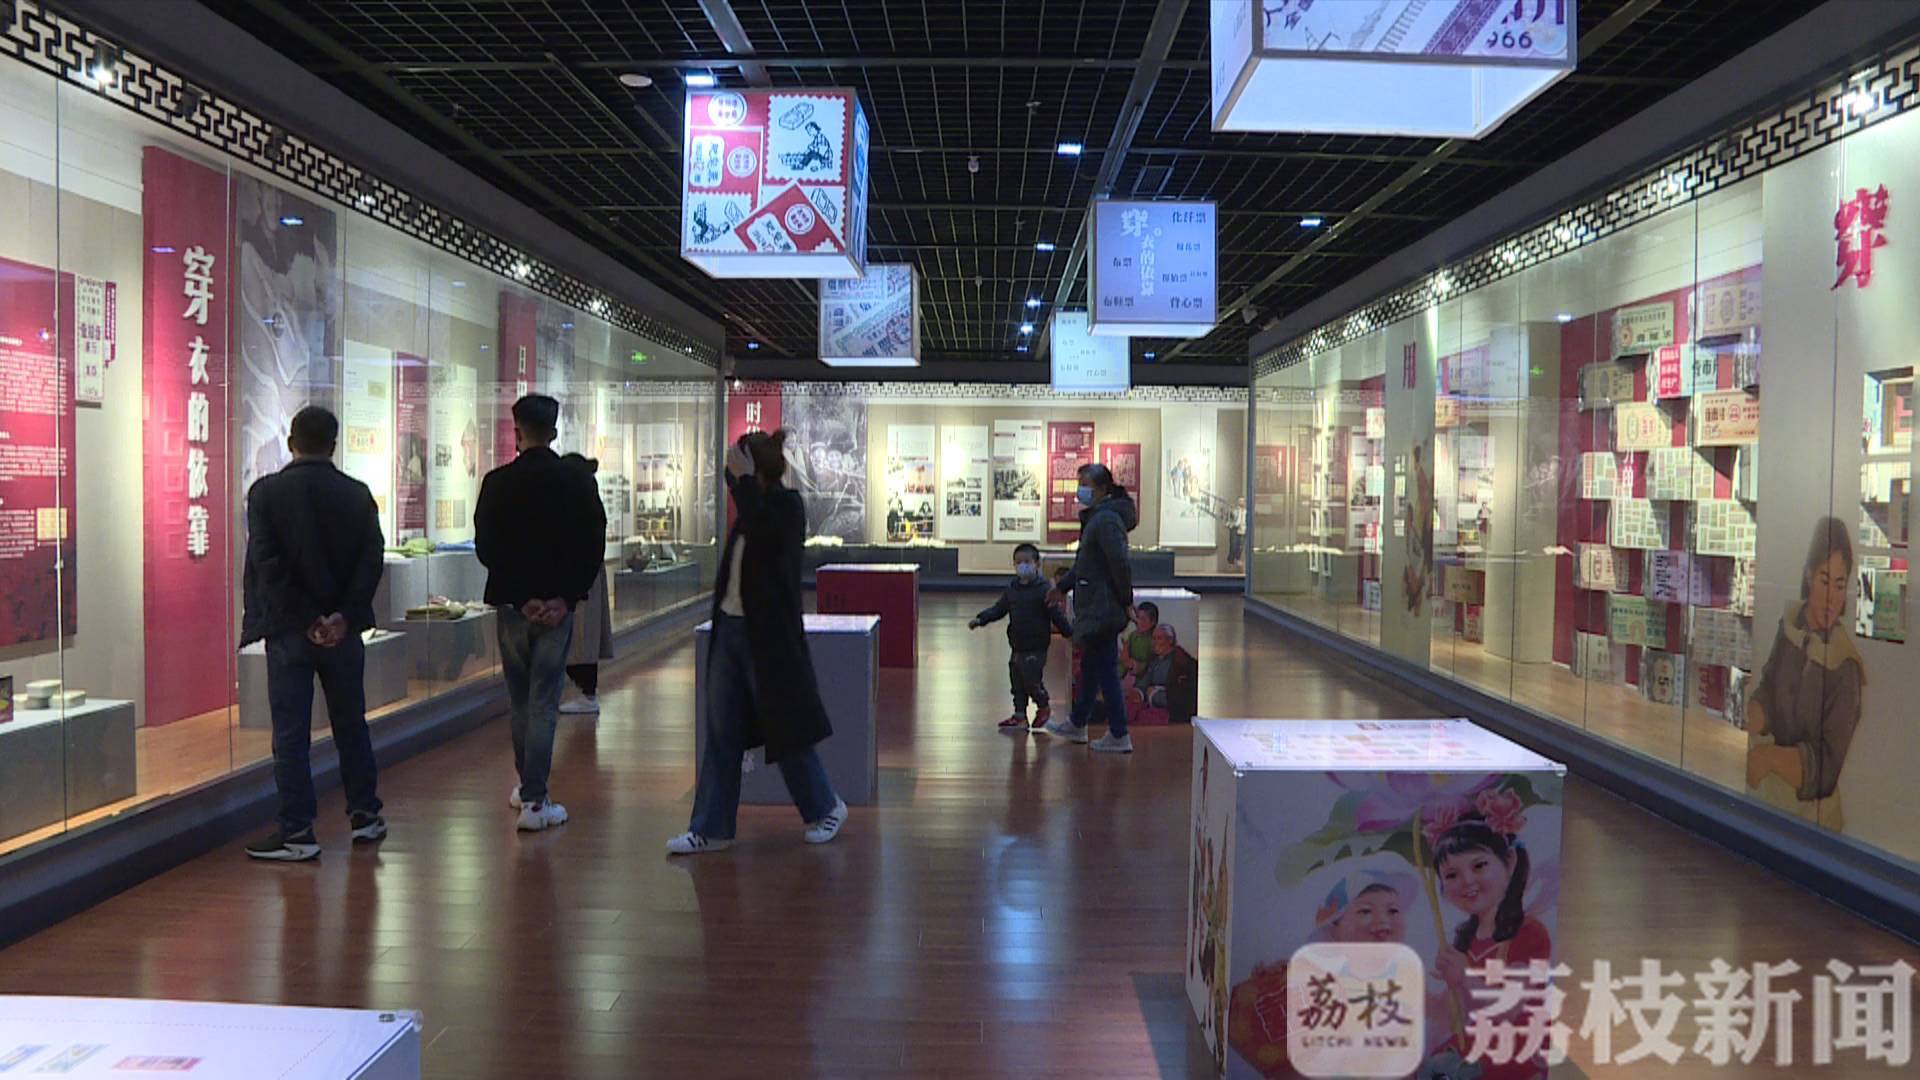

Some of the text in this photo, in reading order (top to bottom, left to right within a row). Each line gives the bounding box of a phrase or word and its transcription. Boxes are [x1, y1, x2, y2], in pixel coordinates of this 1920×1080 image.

[182, 246, 216, 556] 穿衣的依靠
